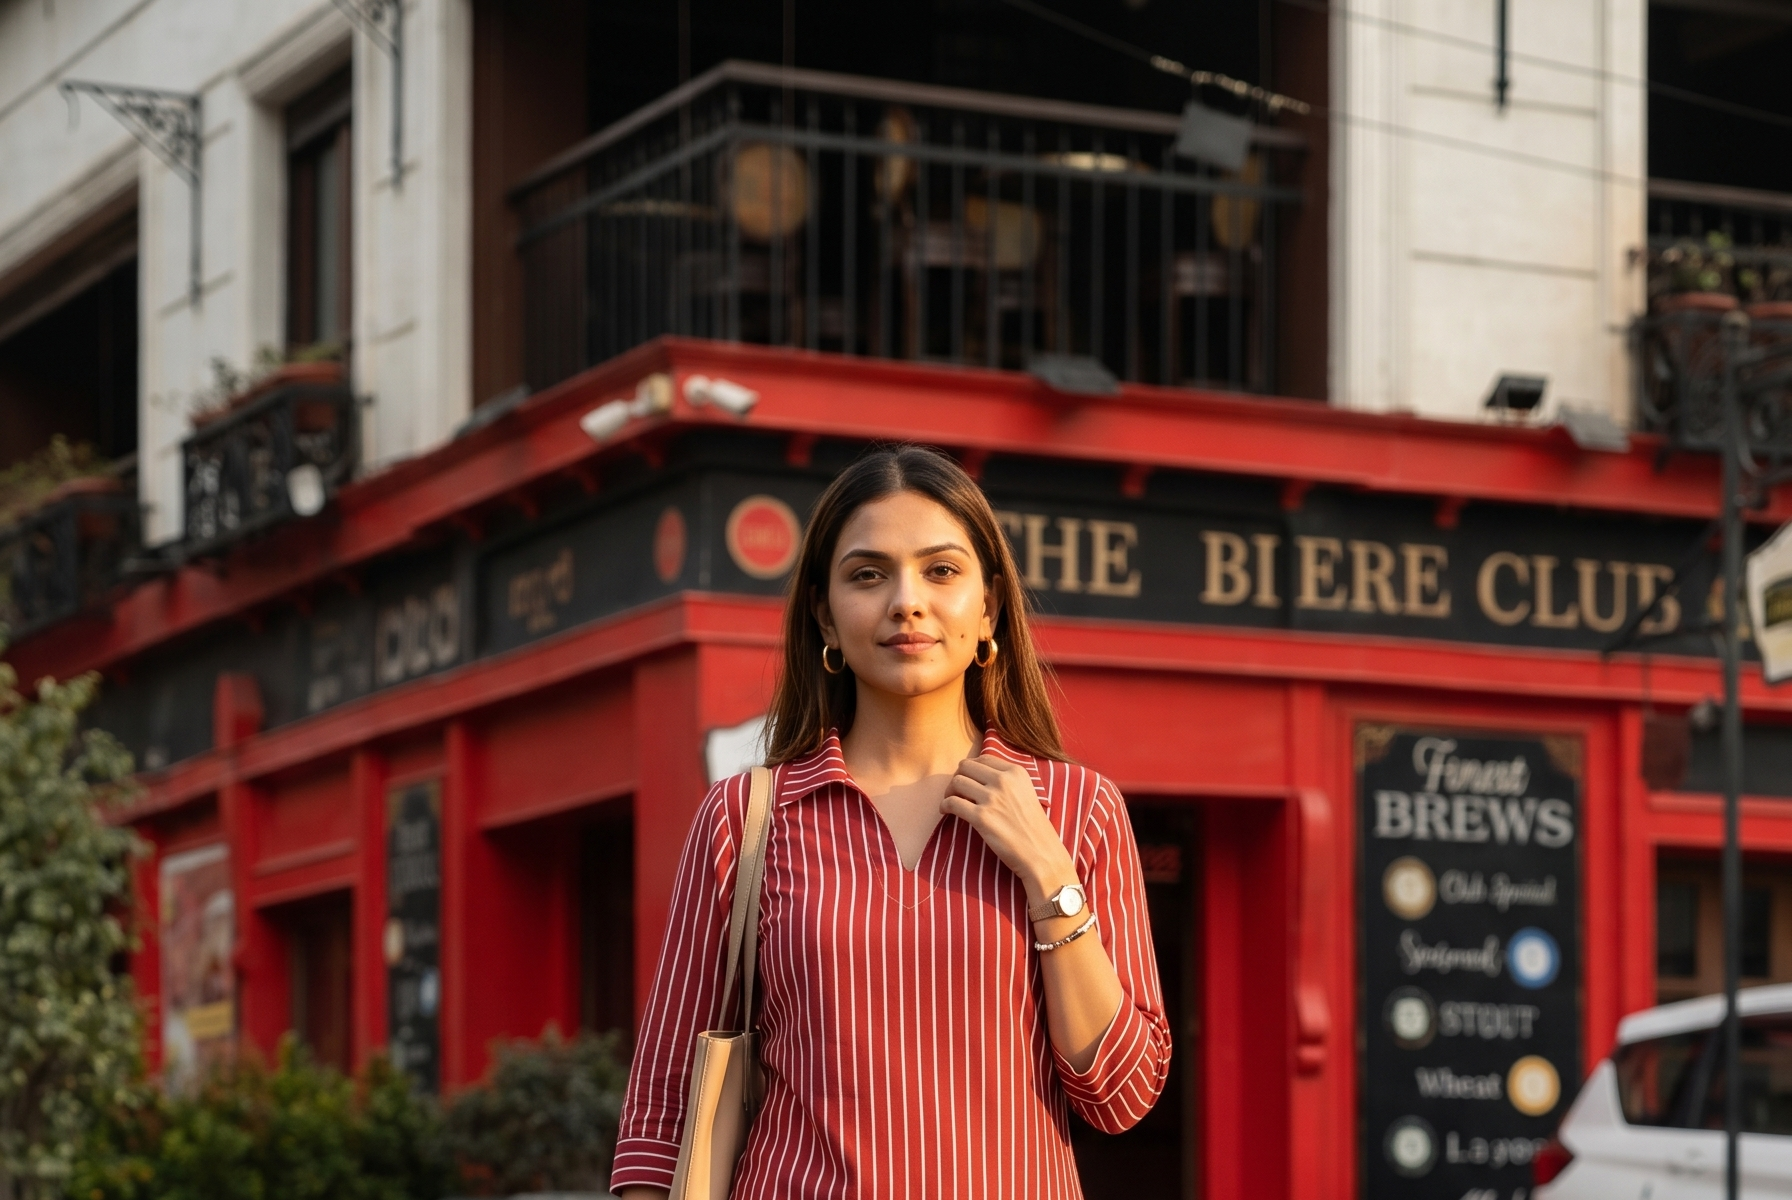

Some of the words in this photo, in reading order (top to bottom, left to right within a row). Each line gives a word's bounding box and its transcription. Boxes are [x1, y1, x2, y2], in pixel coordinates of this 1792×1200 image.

[1200, 530, 1452, 619] BIERE
[1476, 551, 1682, 636] CLUB
[1374, 789, 1574, 848] BREWS
[1438, 1001, 1540, 1039] STOUT
[1415, 1066, 1502, 1099] Wheat
